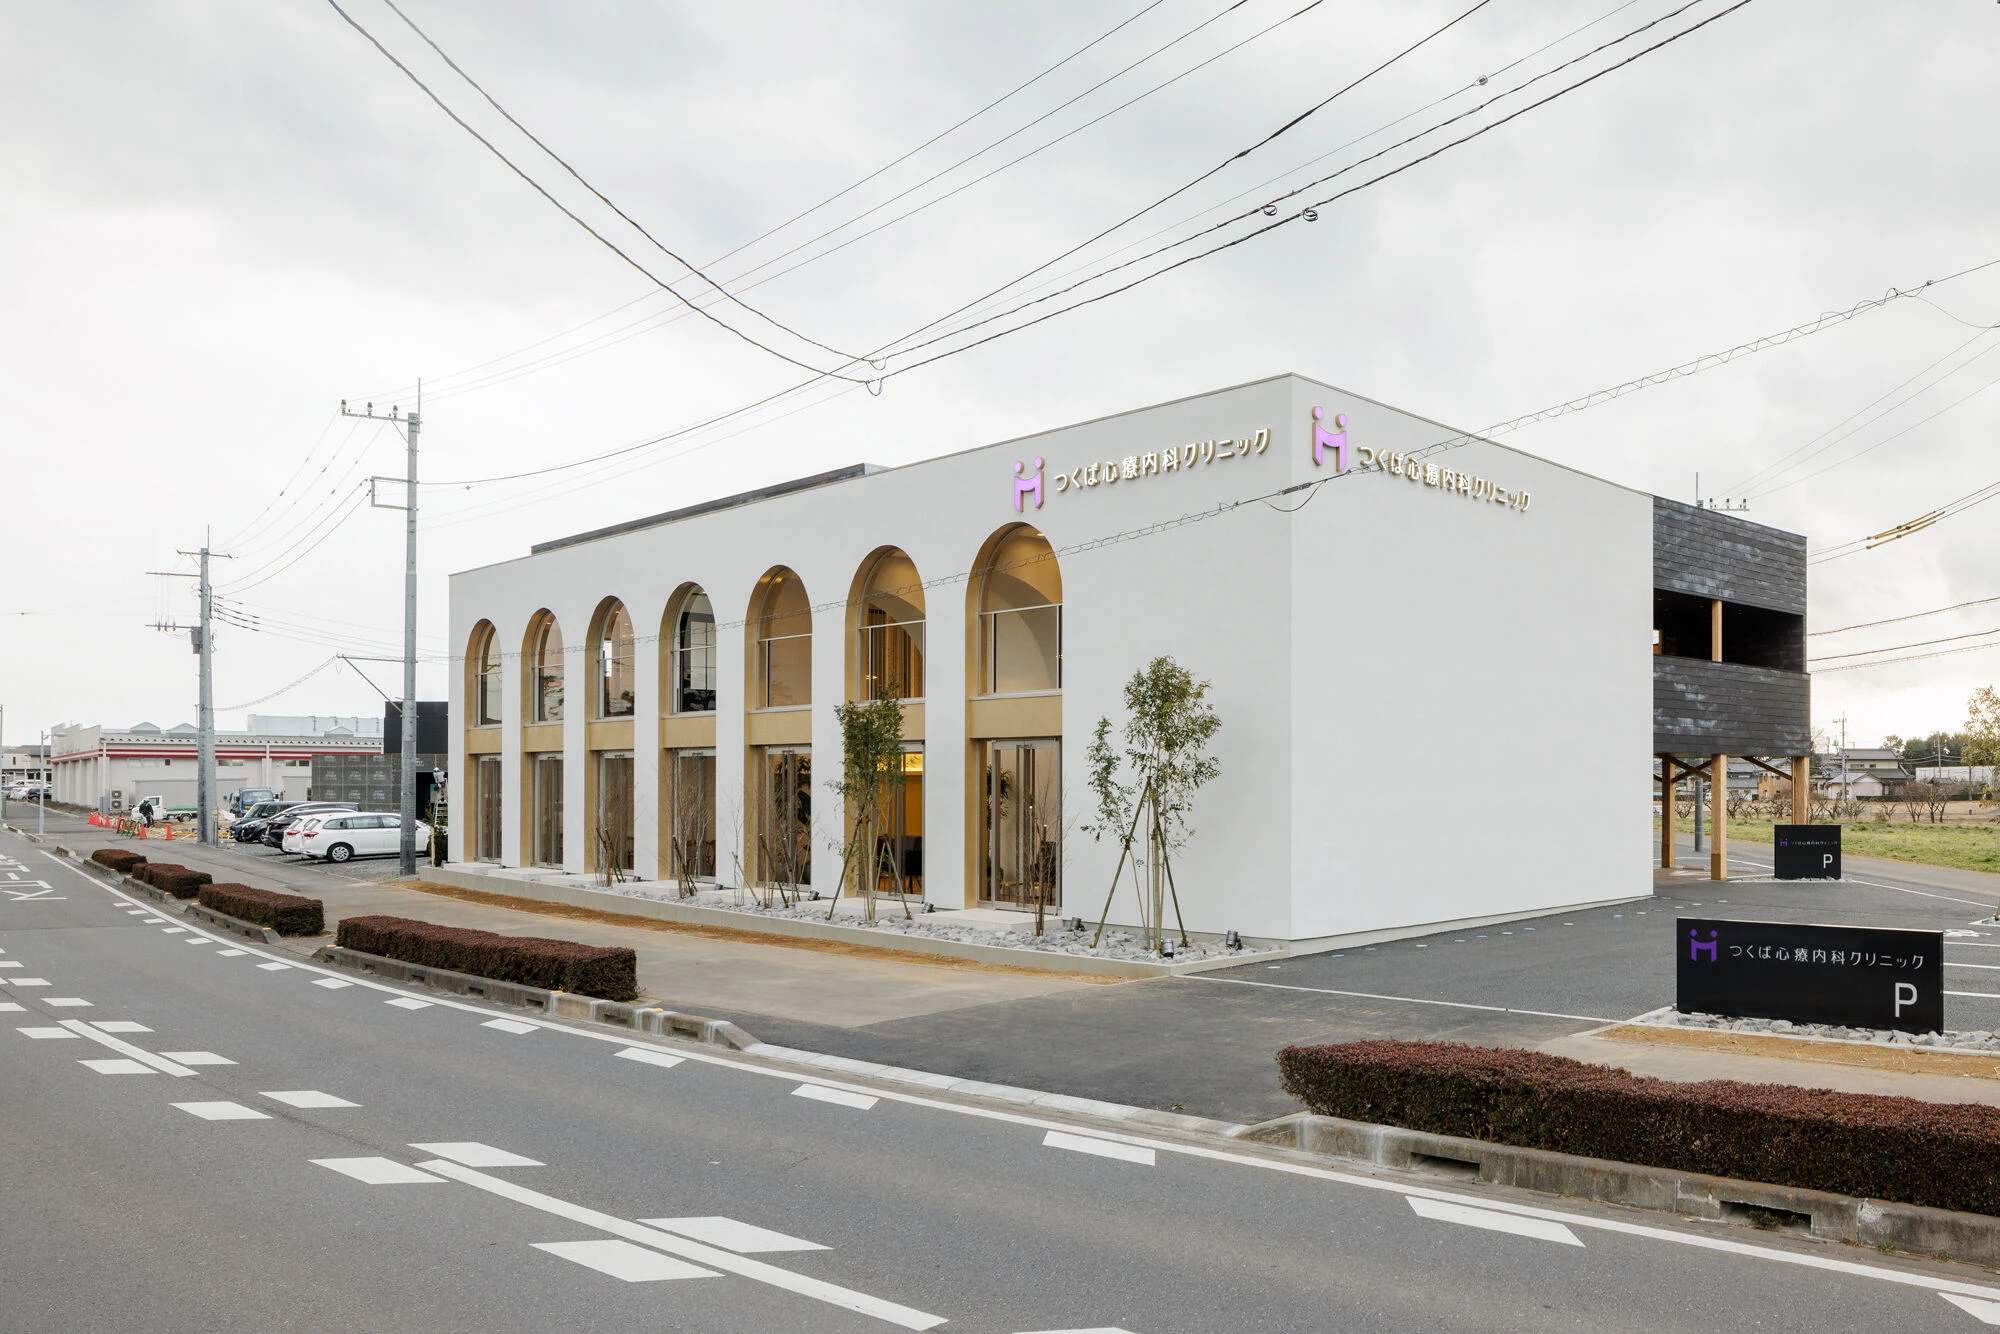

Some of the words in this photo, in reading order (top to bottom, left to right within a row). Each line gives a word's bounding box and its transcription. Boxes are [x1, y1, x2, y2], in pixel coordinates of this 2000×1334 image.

[1053, 427, 1271, 492] つくば心療内科クリニック
[1357, 446, 1532, 512] つくば心療内科クリニック
[1823, 853, 1833, 869] P
[1729, 945, 1924, 970] つくば心療内科クリニック
[1894, 982, 1918, 1018] P
